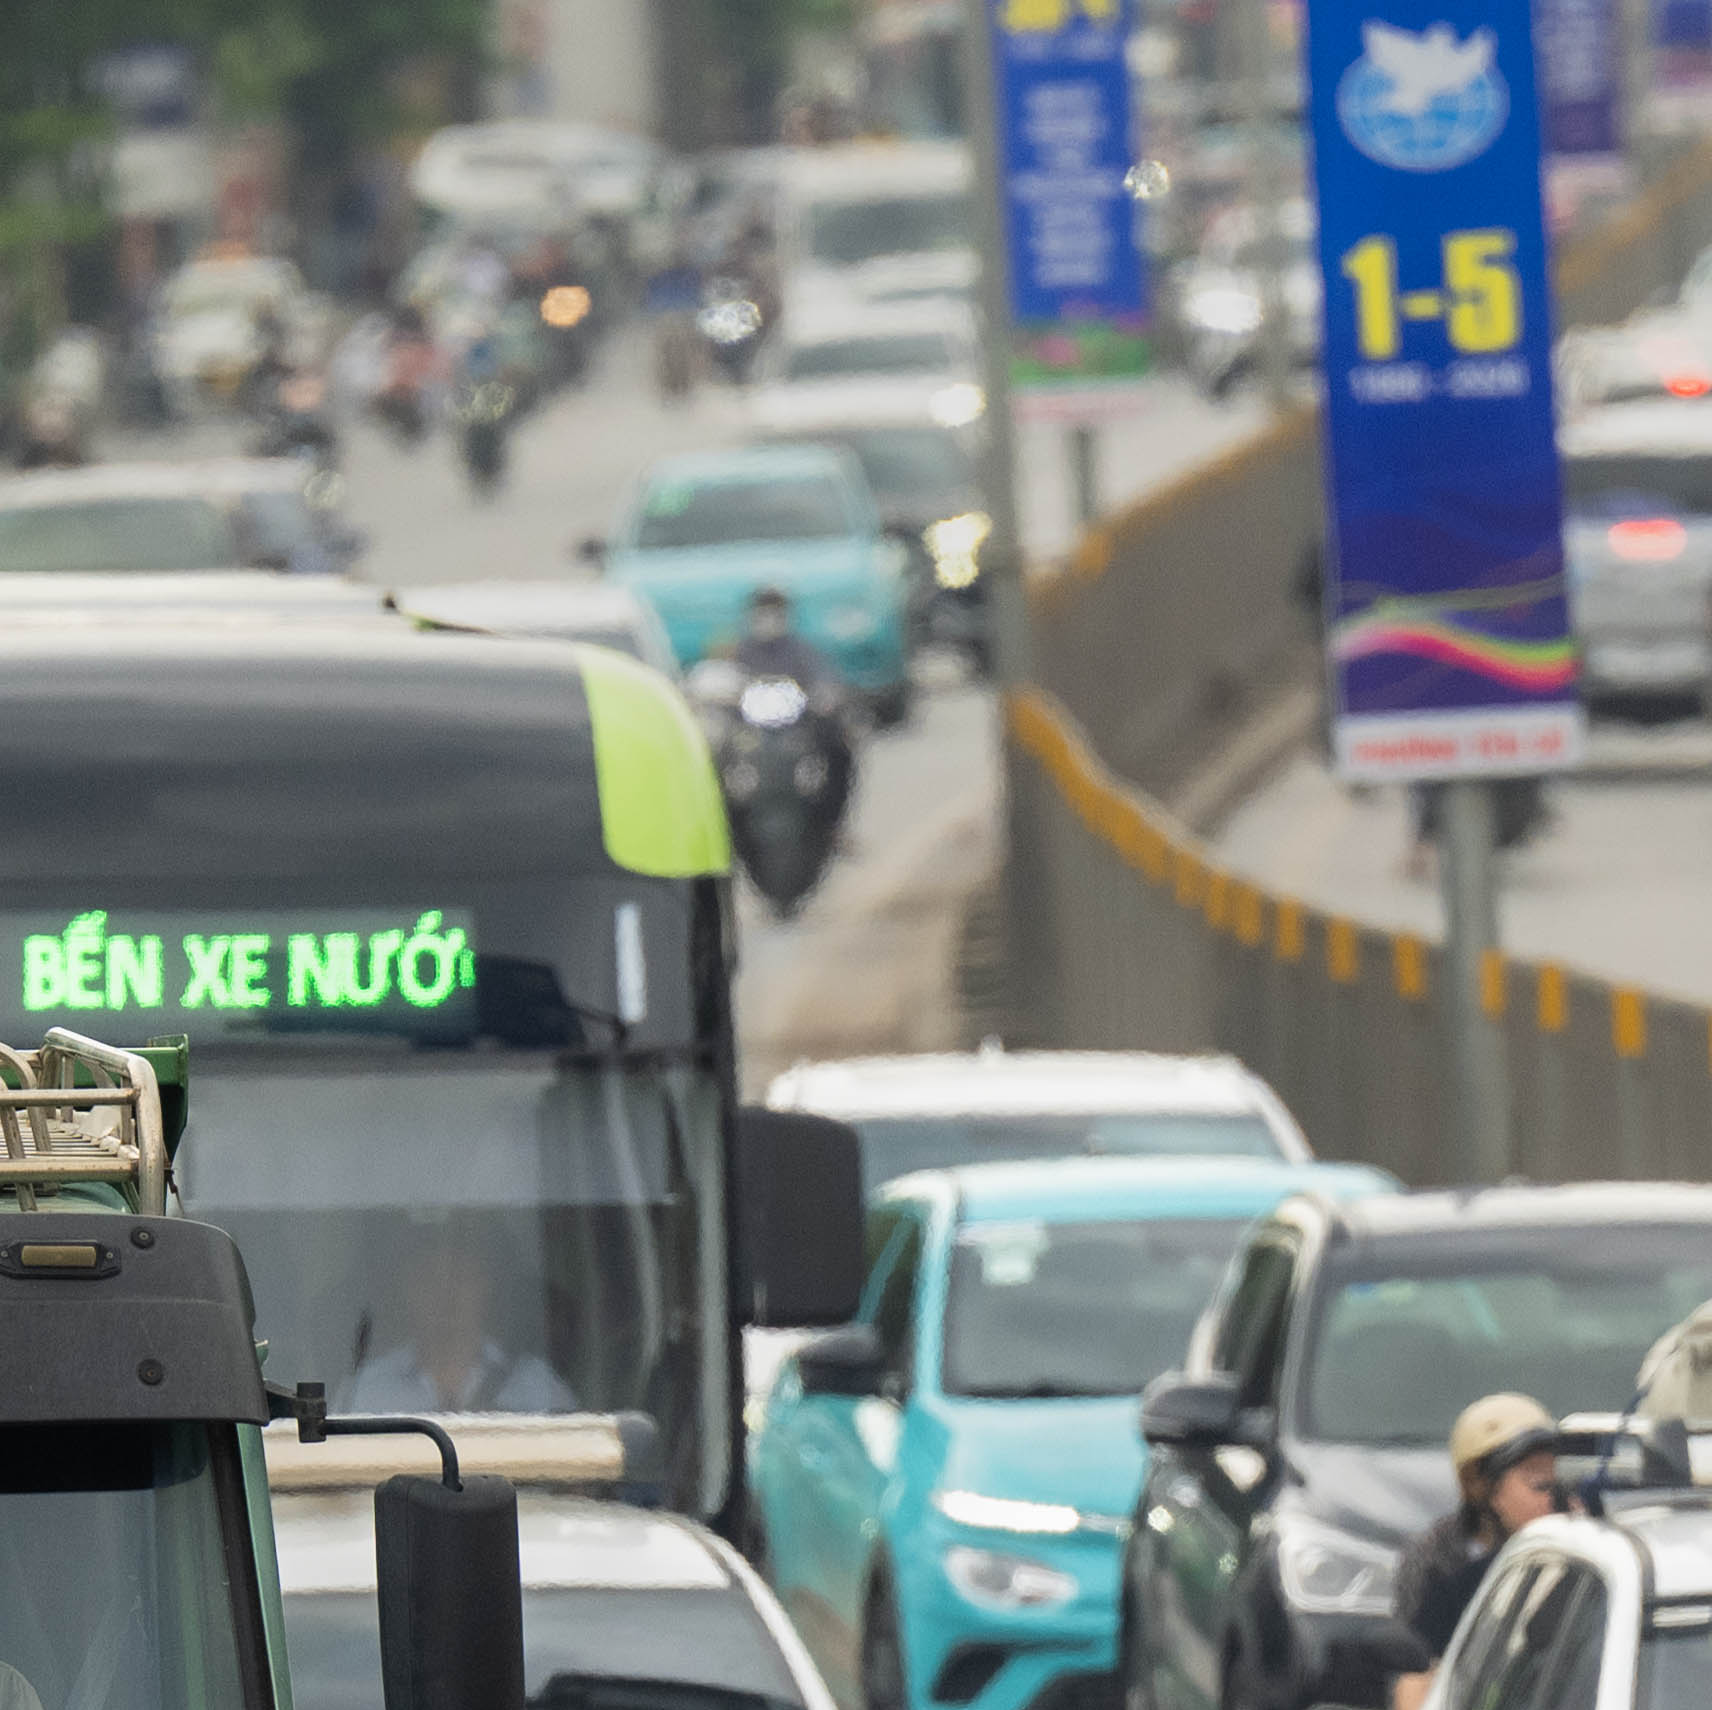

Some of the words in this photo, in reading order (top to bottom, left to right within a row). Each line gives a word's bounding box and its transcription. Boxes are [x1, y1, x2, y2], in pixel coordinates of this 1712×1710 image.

[1341, 228, 1525, 361] 1-5
[22, 910, 164, 1012] BẾN
[181, 934, 270, 1009] XE
